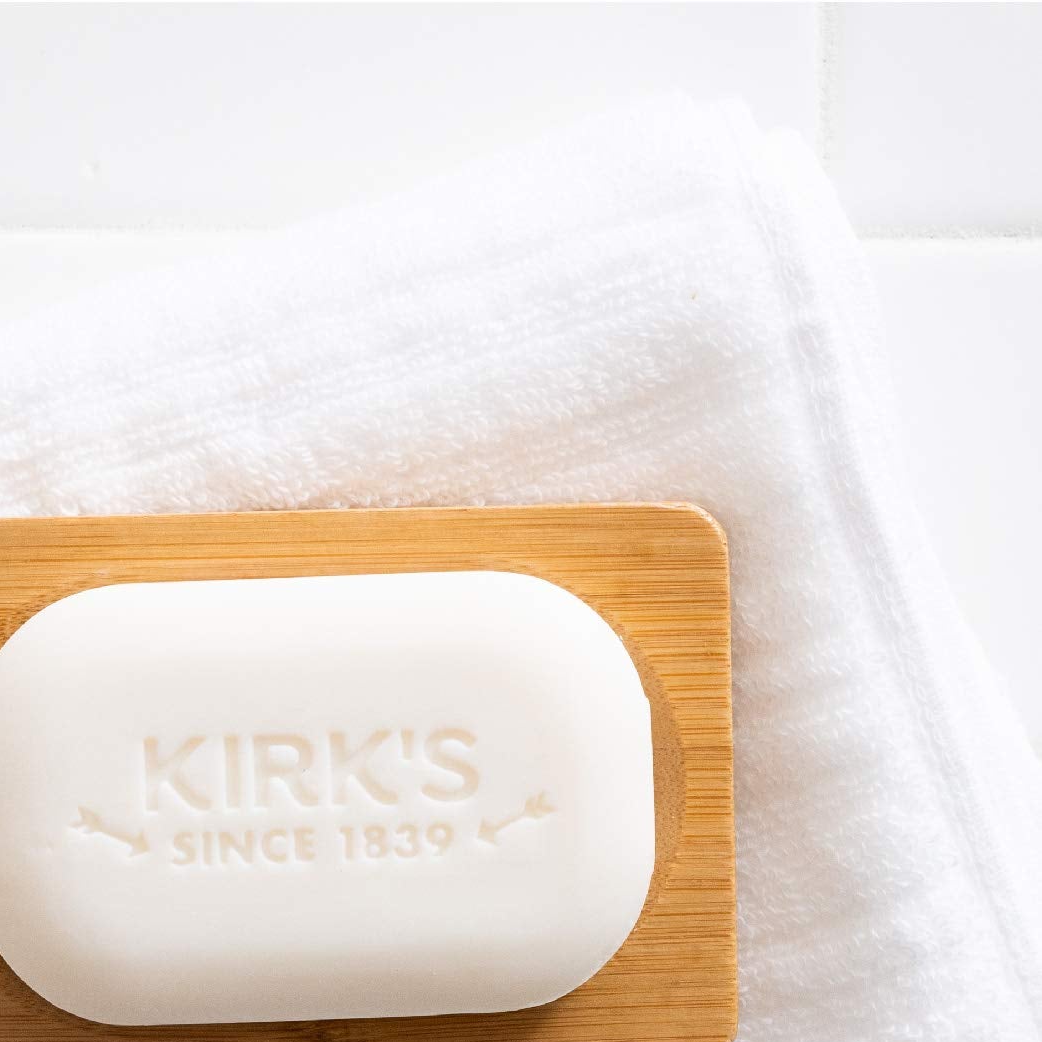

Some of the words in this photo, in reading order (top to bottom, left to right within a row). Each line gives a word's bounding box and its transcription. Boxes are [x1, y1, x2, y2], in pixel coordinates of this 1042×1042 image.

[143, 727, 481, 811] KIRK'S
[170, 825, 317, 866] SINCE
[339, 822, 455, 861] 1839
